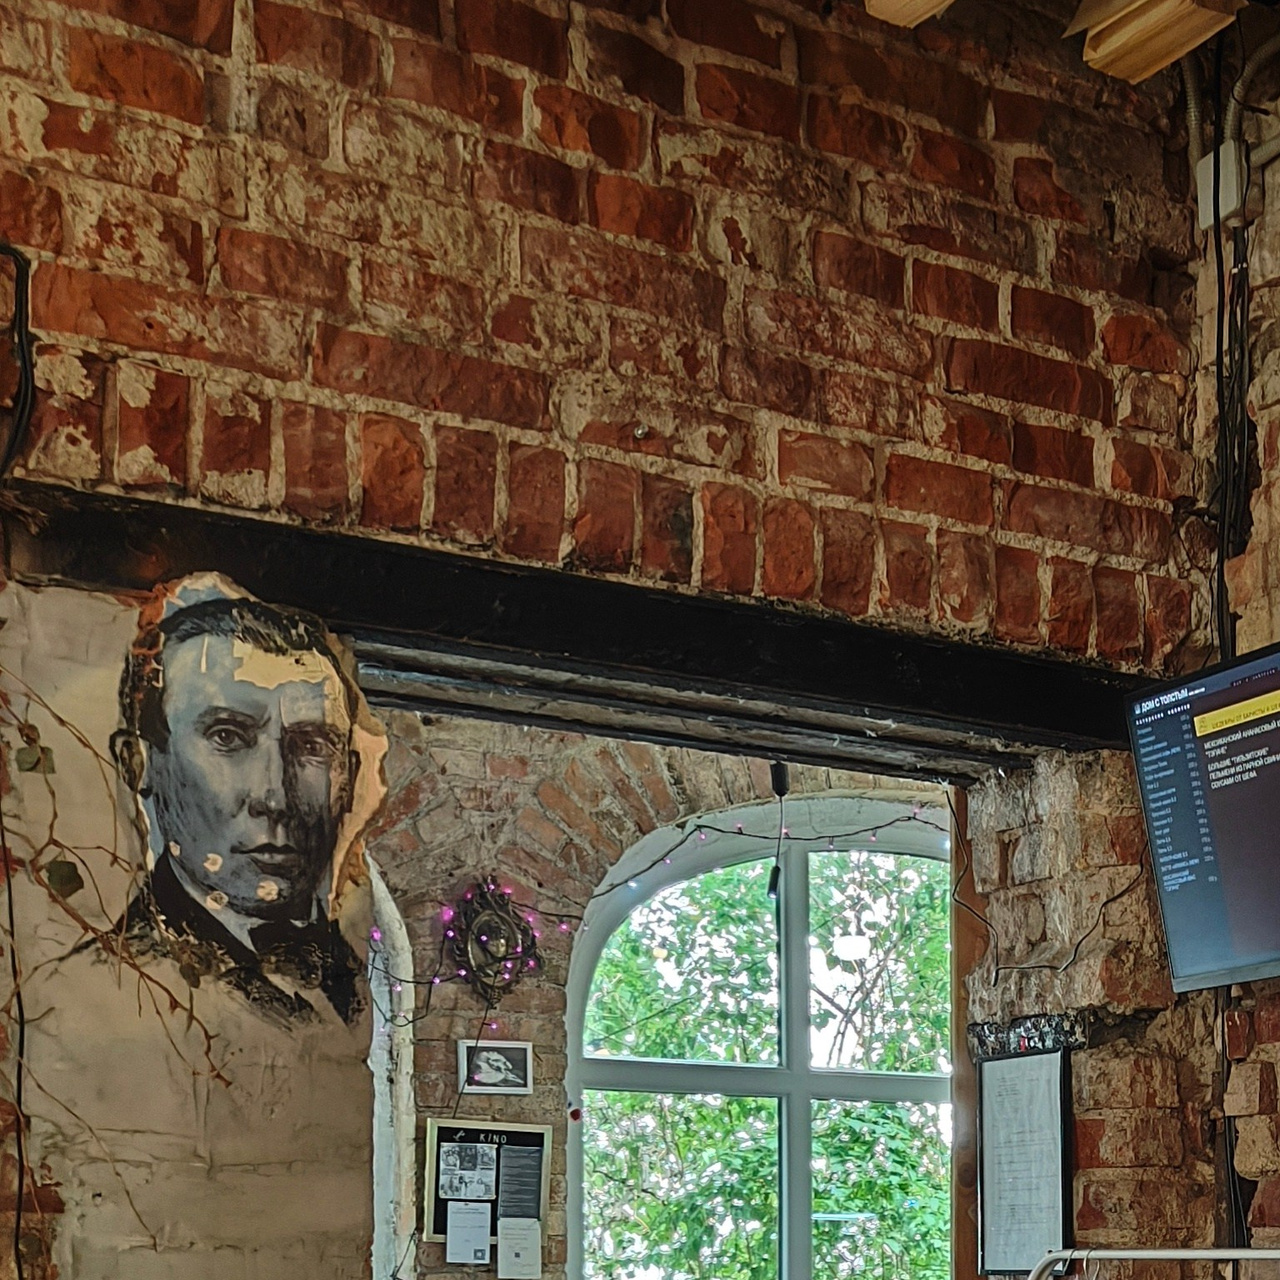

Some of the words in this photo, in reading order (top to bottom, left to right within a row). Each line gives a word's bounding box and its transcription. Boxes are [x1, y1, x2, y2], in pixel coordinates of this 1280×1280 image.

[1141, 701, 1155, 713] ДОМ
[1160, 688, 1188, 706] ТОЛСТЫМ
[479, 1133, 507, 1144] KINO
